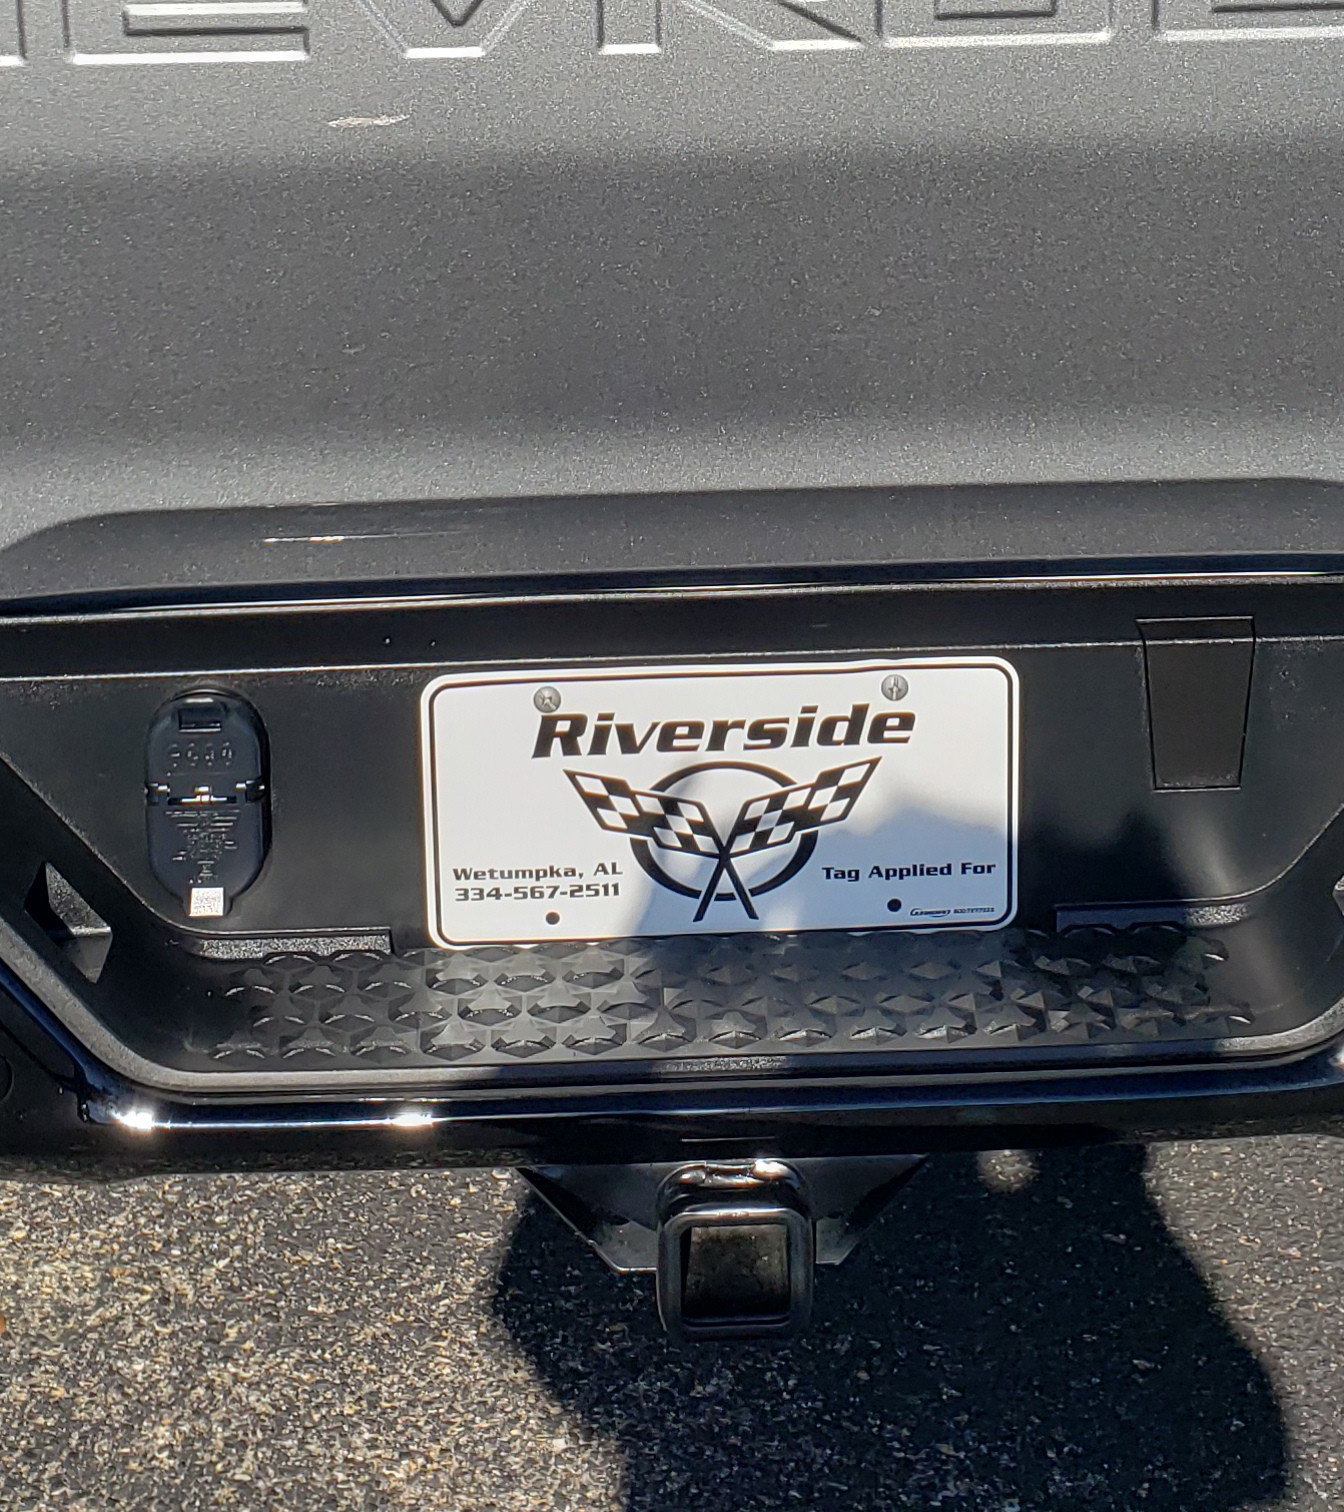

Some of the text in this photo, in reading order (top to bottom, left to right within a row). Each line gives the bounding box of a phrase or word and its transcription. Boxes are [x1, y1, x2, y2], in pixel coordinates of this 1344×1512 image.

[531, 703, 917, 760] Riverside
[452, 861, 624, 882] Wetumpka, AL
[821, 862, 997, 883] Tag Applied For
[454, 881, 621, 902] 334-567-2511
